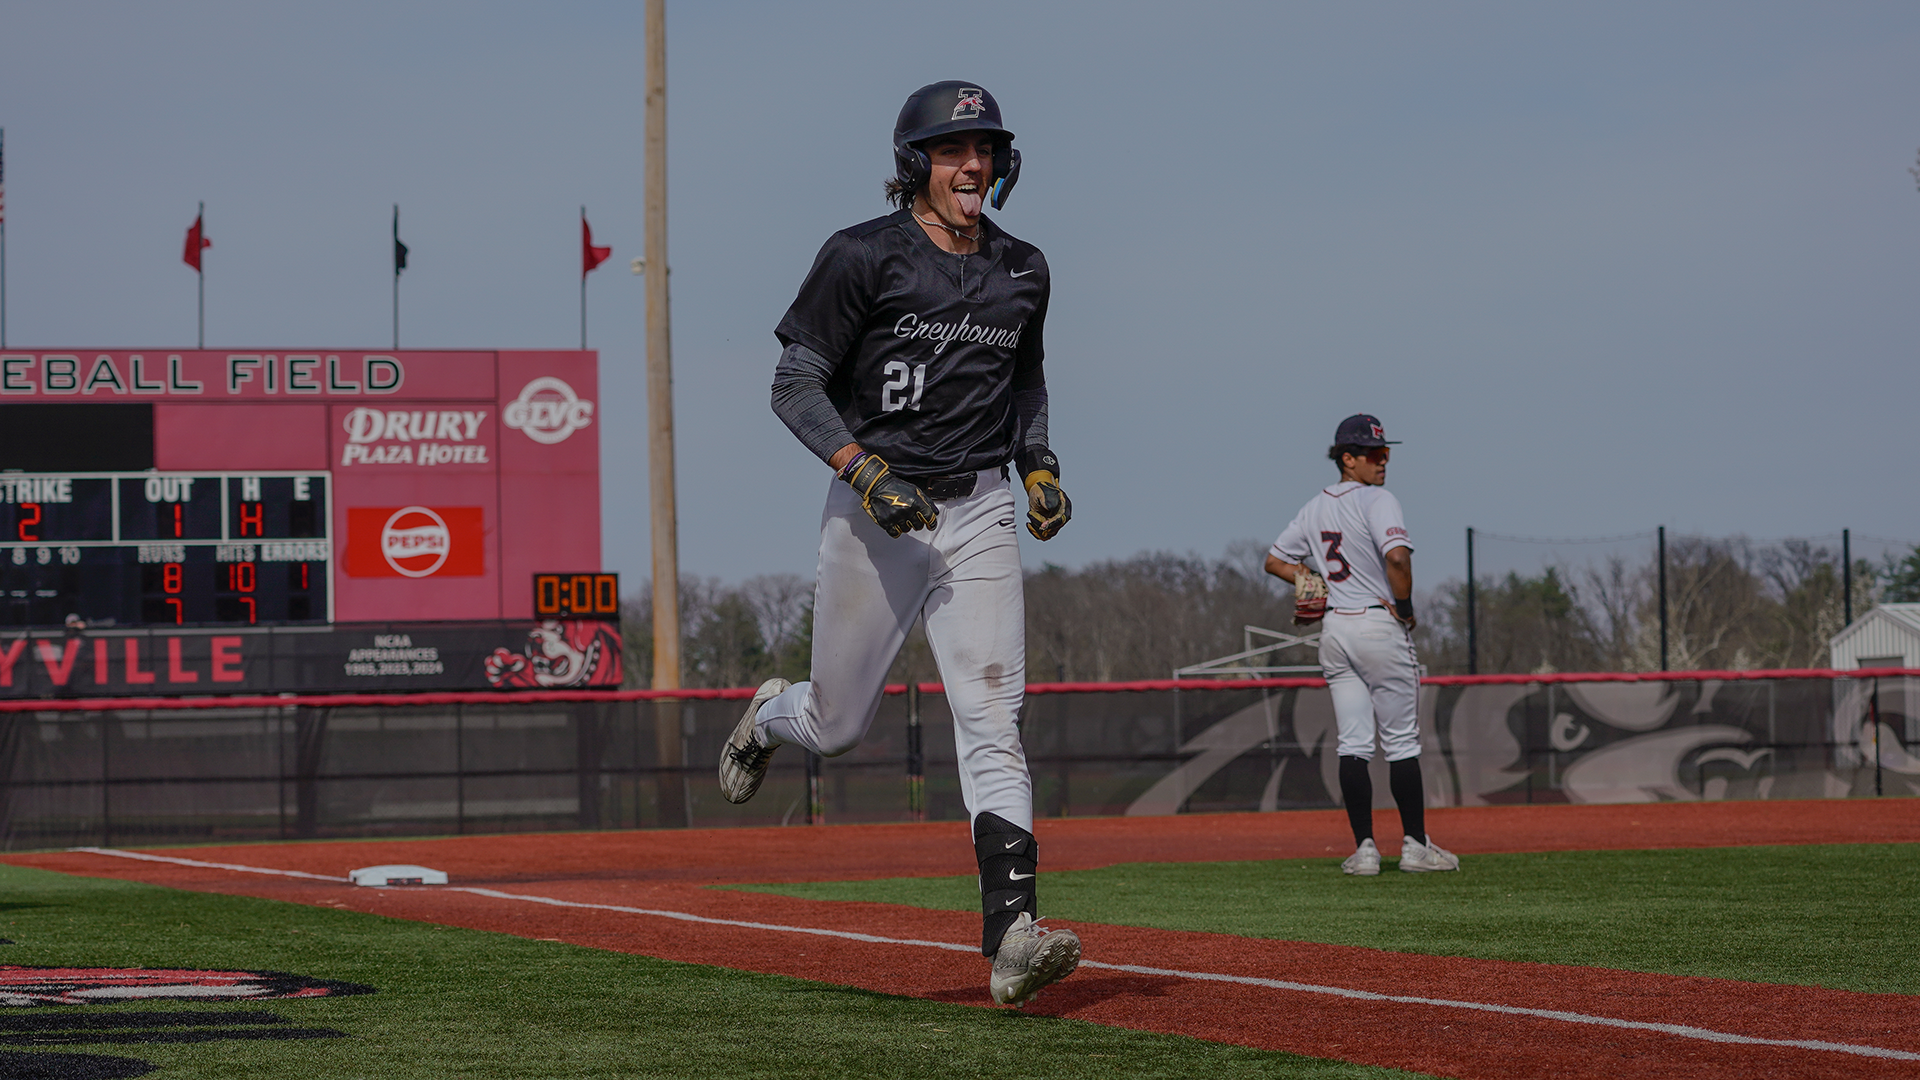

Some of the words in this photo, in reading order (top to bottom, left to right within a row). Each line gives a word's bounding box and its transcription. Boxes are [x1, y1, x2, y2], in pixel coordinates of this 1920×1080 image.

[1, 355, 204, 394] EBALL
[227, 354, 405, 394] FIELD
[882, 360, 926, 411] 21
[343, 407, 487, 443] DRURY
[502, 399, 594, 430] GLVC
[341, 443, 413, 466] PLAZA
[417, 442, 490, 466] HOTEL
[144, 477, 194, 502] OUT
[242, 476, 261, 501] H
[294, 476, 310, 501] E
[18, 502, 41, 541] 2
[174, 503, 182, 538] 1
[12, 547, 27, 565] 8
[36, 547, 51, 565] 9
[58, 546, 81, 565] 10
[138, 545, 186, 563] RUNS
[216, 544, 256, 562] HITS
[261, 543, 328, 562] ERRORS
[388, 535, 443, 548] PEPSI
[1321, 531, 1351, 583] 3
[163, 562, 182, 593] 8
[229, 562, 256, 592] 10
[301, 562, 308, 590] 1
[537, 574, 618, 613] 0:00
[165, 598, 183, 625] 7
[239, 597, 256, 624] 7
[348, 647, 438, 662] APPEARANCES
